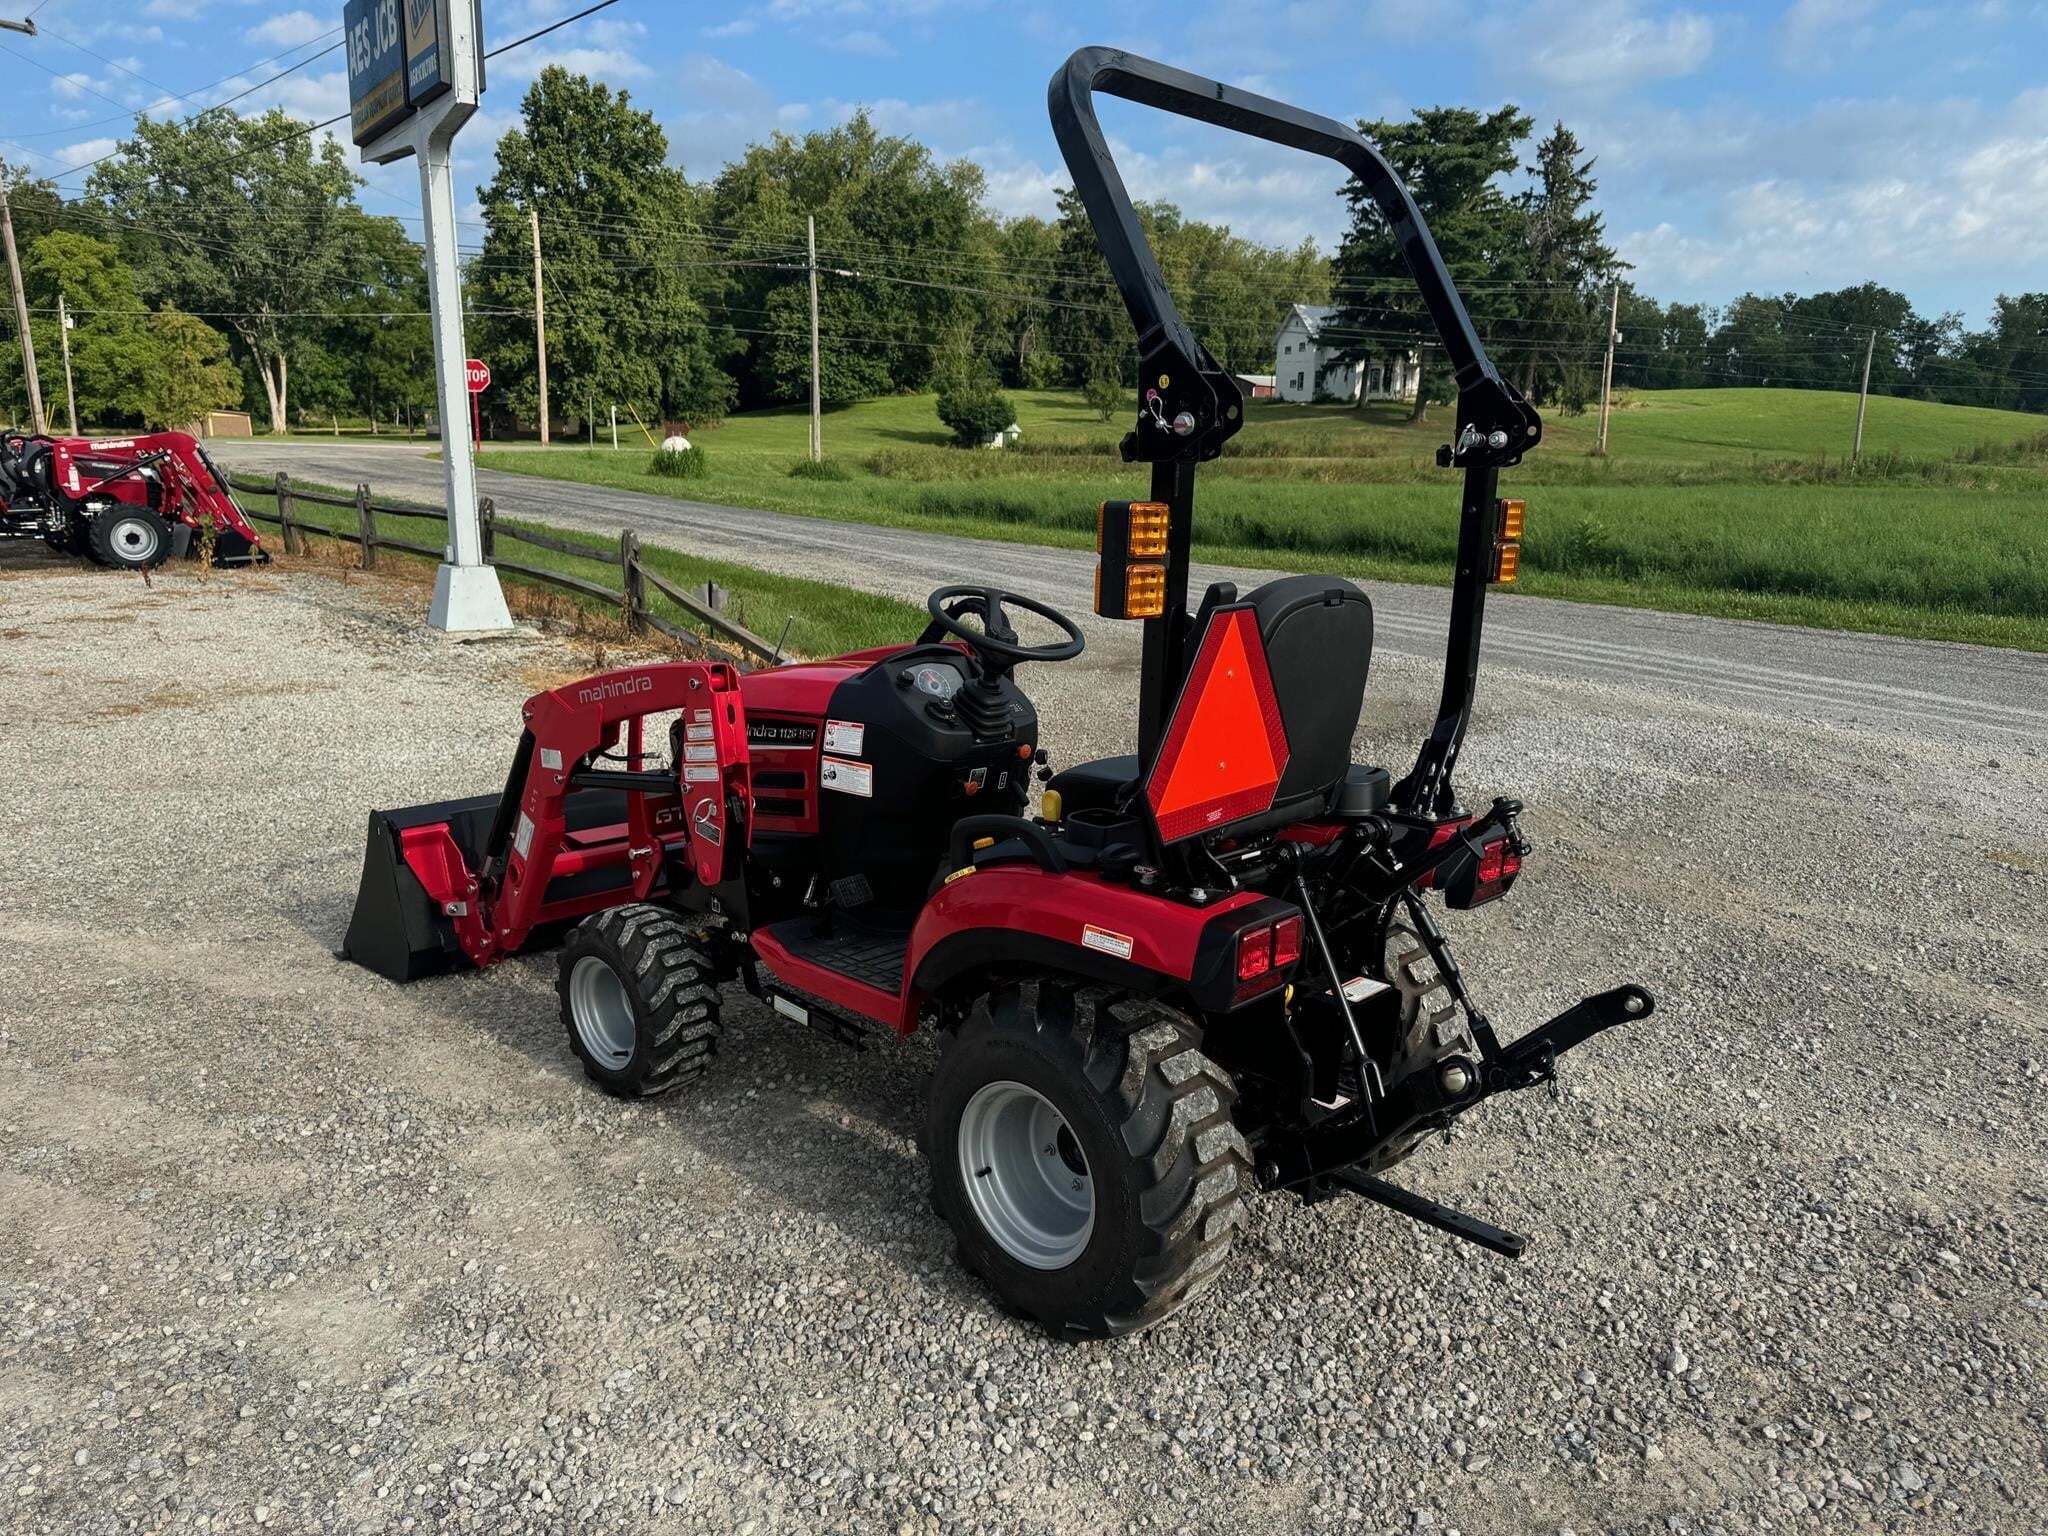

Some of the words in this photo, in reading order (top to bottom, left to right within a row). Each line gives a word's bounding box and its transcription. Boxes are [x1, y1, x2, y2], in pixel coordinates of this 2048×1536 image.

[349, 15, 370, 80] AES
[373, 0, 398, 60] JCB
[466, 369, 488, 382] TOP
[579, 675, 652, 704] mahindra
